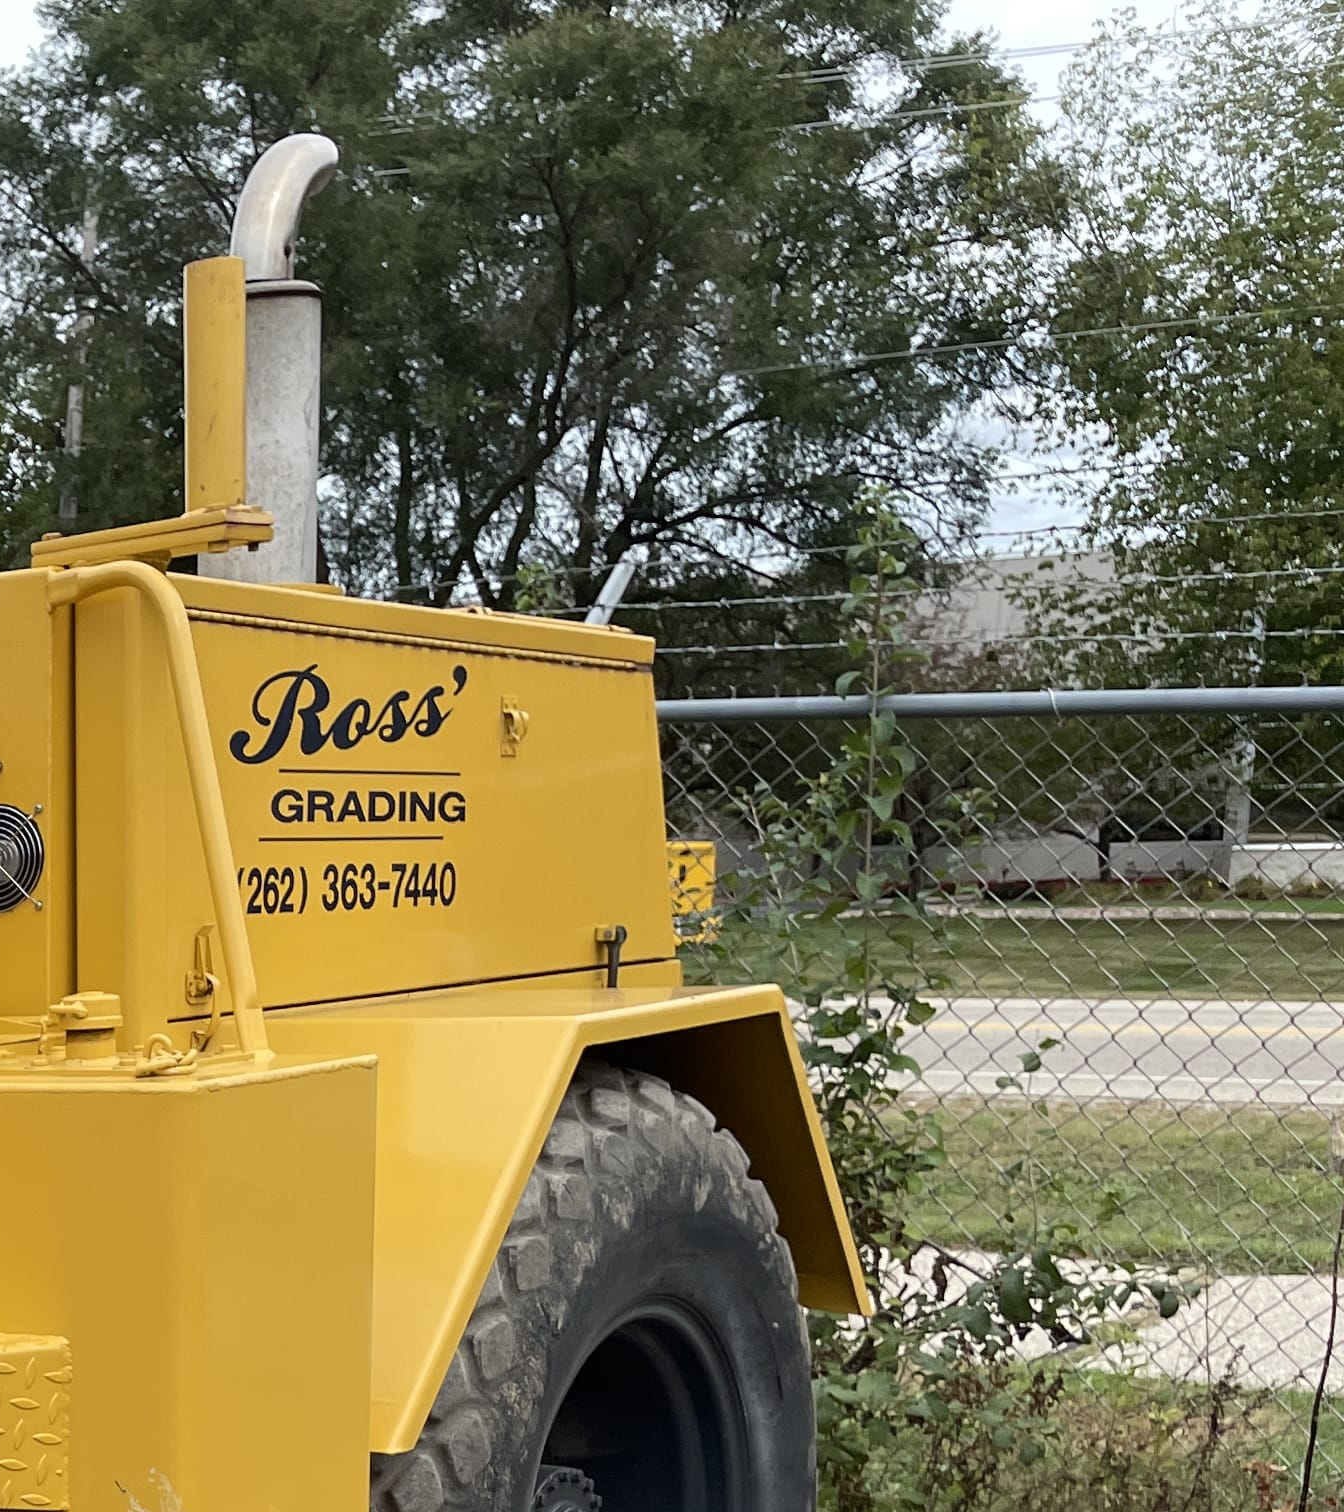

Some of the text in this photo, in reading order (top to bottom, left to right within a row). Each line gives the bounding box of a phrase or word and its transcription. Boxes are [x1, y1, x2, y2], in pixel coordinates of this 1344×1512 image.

[229, 663, 468, 765] Ross'
[270, 789, 467, 824] GRADING
[321, 861, 457, 912] 363-7440
